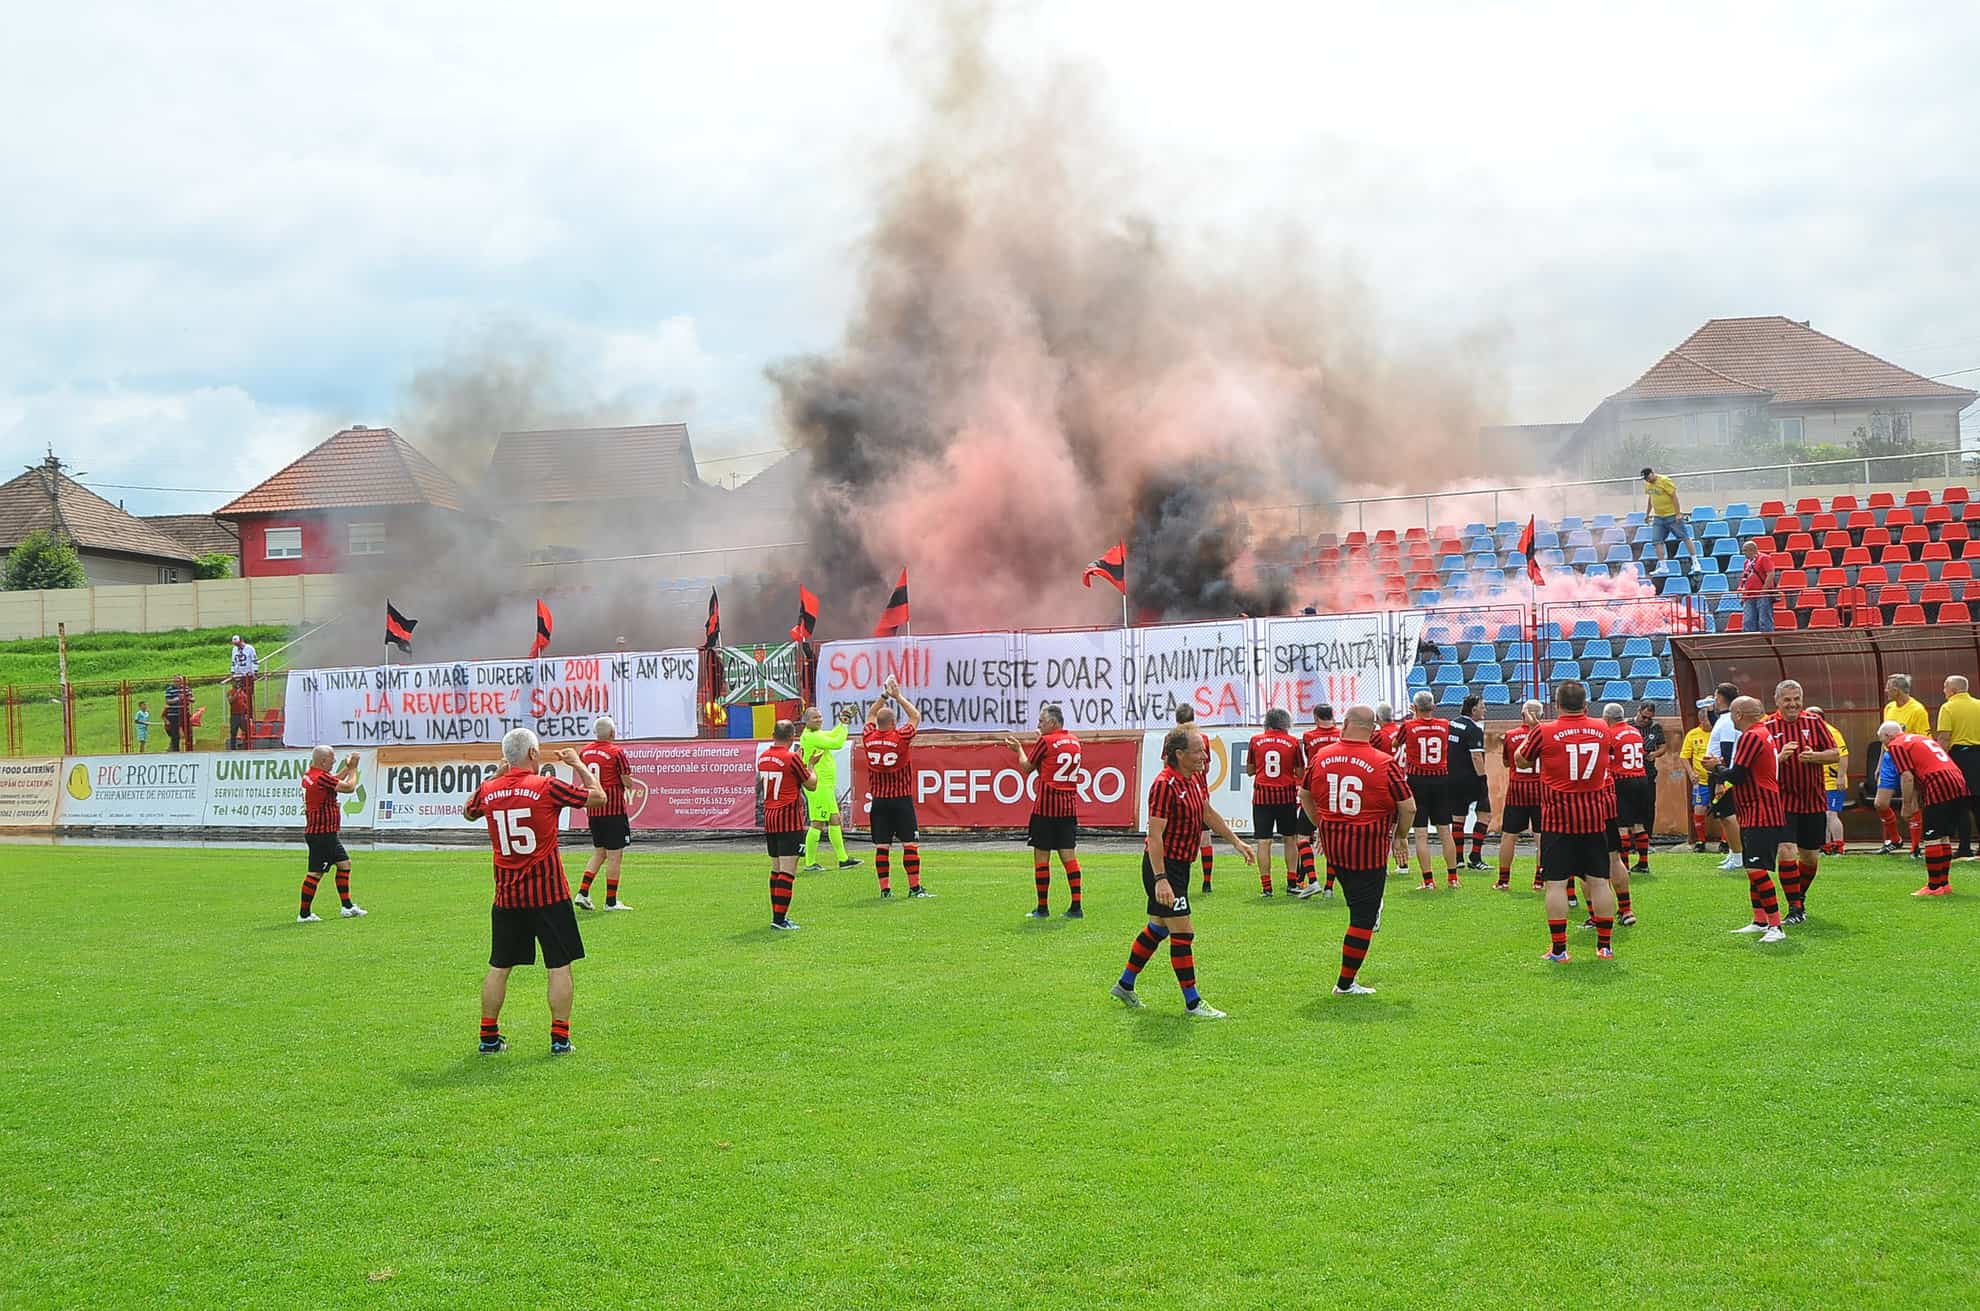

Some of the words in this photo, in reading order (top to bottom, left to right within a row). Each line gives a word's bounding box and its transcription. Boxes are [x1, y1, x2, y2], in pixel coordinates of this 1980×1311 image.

[326, 672, 368, 691] INIMA
[414, 672, 422, 688] O
[428, 665, 469, 688] MARE
[477, 665, 534, 686] DURERE
[540, 662, 556, 683] IN
[565, 658, 600, 681] 2001
[611, 661, 630, 681] NE
[636, 658, 657, 679] AM
[662, 657, 694, 681] SPUS
[946, 658, 976, 687] NU
[982, 659, 1038, 689] ESTE
[1047, 656, 1112, 690] DOAR
[1124, 656, 1136, 685] O
[529, 683, 609, 718] SOIMII
[1070, 698, 1116, 725] VOR
[1194, 682, 1241, 718] SA
[342, 719, 416, 740] TIMPUL
[426, 718, 489, 740] INAPOI
[537, 716, 590, 736] CERE
[692, 746, 740, 758] alimentare
[1418, 737, 1441, 764] 13
[1566, 743, 1599, 781] 17
[1622, 743, 1643, 769] 35
[1922, 739, 1949, 762] 5
[97, 766, 122, 785] PIC
[127, 764, 200, 785] PROTECT
[216, 759, 312, 781] UNITRAN
[657, 762, 699, 775] personale
[1053, 753, 1081, 782] 22
[1265, 751, 1280, 778] 8
[96, 790, 144, 801] ECHIPAMENTE
[145, 790, 155, 800] DE
[245, 788, 270, 798] TOTALE
[514, 788, 540, 800] SIBIU
[760, 771, 783, 800] 77
[1327, 773, 1363, 816] 16
[213, 805, 228, 816] Tel
[230, 805, 249, 816] +40
[252, 805, 277, 818] (745)
[280, 805, 297, 816] 308
[493, 808, 536, 856] 15
[1174, 897, 1188, 911] 23
